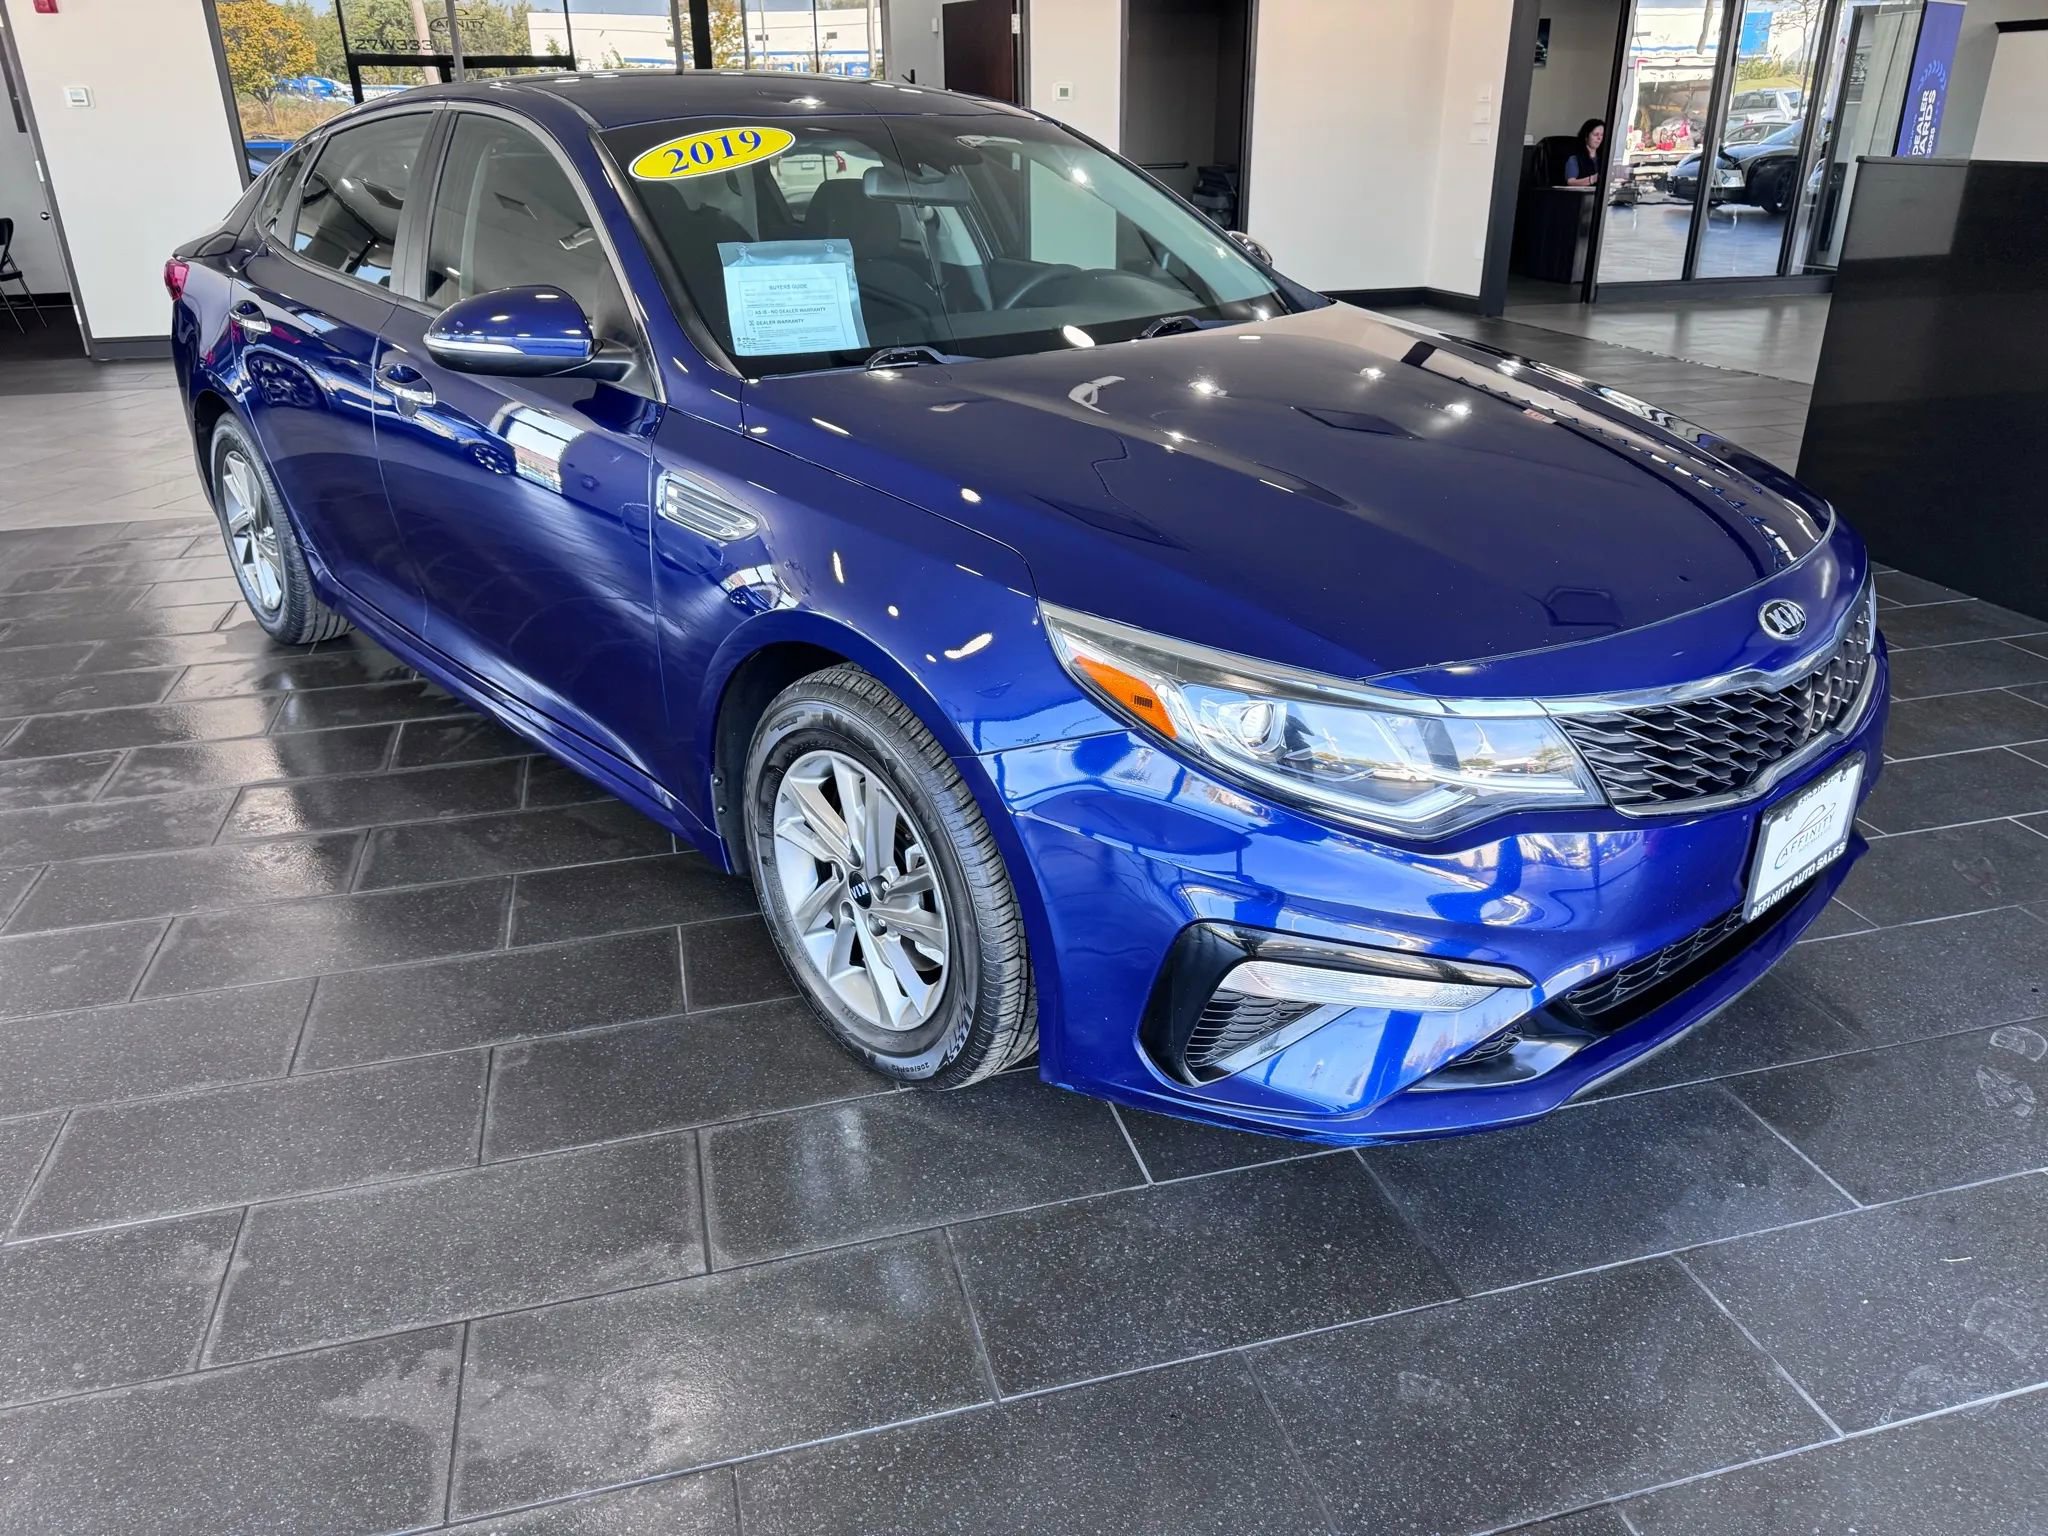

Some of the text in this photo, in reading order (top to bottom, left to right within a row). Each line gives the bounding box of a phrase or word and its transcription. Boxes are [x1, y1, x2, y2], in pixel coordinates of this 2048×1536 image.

[355, 39, 433, 50] 27W333
[1912, 90, 1929, 155] DEALER
[1918, 89, 1936, 155] ARDS
[663, 130, 762, 174] 2019
[1780, 811, 1835, 860] AFFINITY
[850, 881, 869, 899] KIA
[1750, 841, 1846, 920] AFFINITY AUTO SALES
